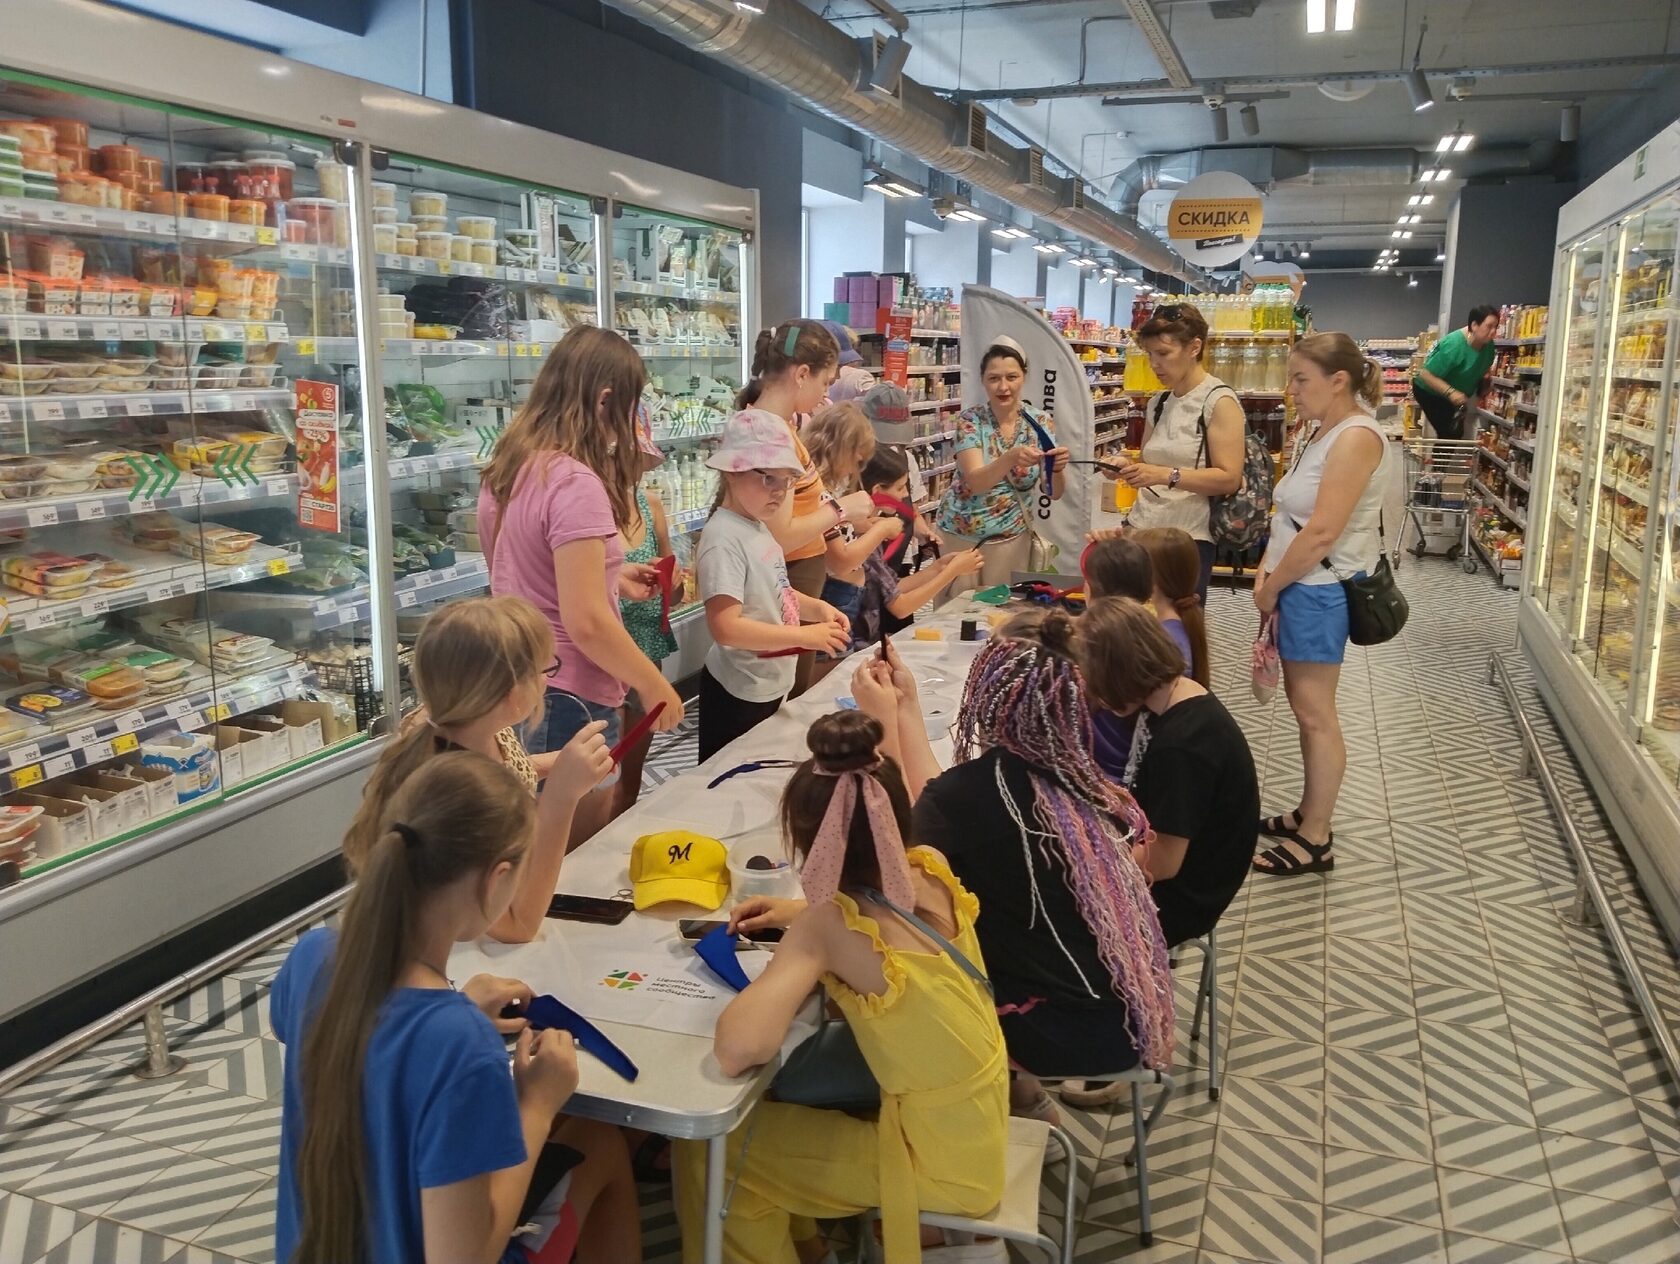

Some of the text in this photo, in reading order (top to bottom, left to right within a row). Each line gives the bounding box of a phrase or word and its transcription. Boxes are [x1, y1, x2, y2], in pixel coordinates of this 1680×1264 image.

[1177, 210, 1250, 228] СКИДКА
[667, 842, 693, 864] M
[650, 982, 706, 994] местного
[656, 977, 702, 988] Центры
[646, 986, 716, 1000] сообщества
